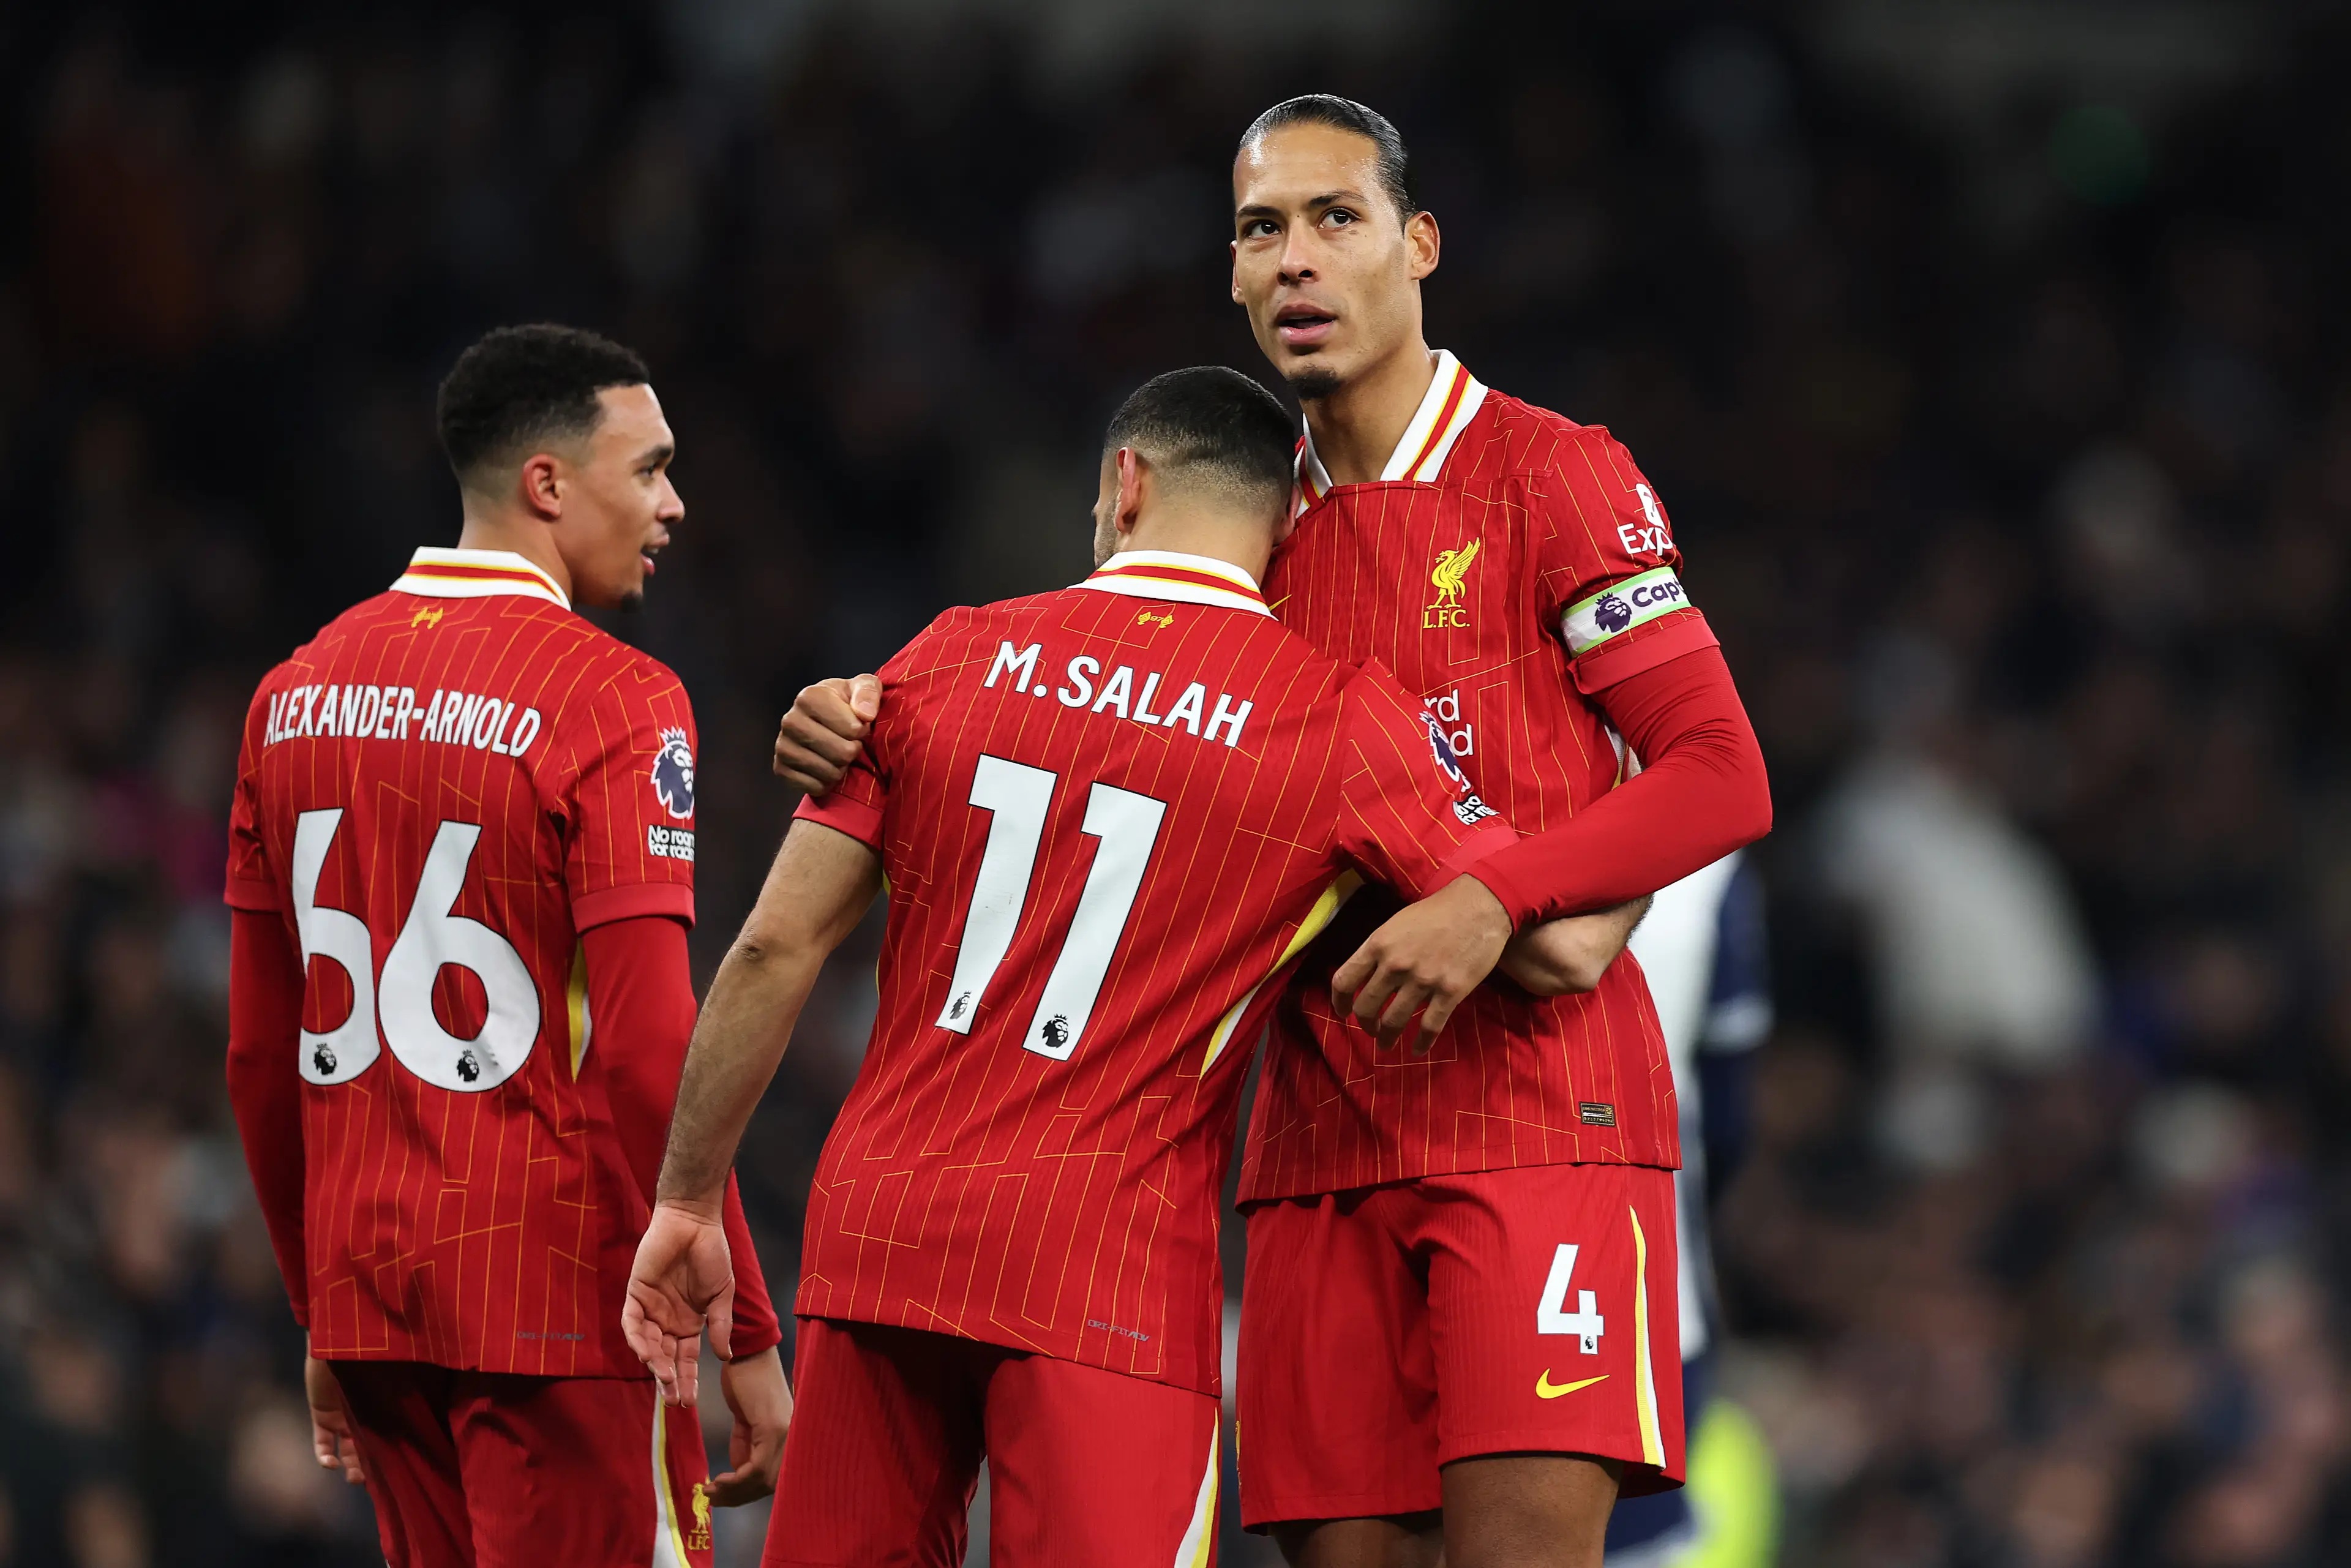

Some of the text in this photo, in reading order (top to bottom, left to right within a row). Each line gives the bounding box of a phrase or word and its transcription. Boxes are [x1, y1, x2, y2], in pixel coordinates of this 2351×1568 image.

[263, 683, 541, 757] ALEXANDER-ARNOLD
[648, 824, 670, 844] No
[291, 808, 541, 1093] 66
[934, 753, 1168, 1061] 11
[1537, 1244, 1604, 1355] 4
